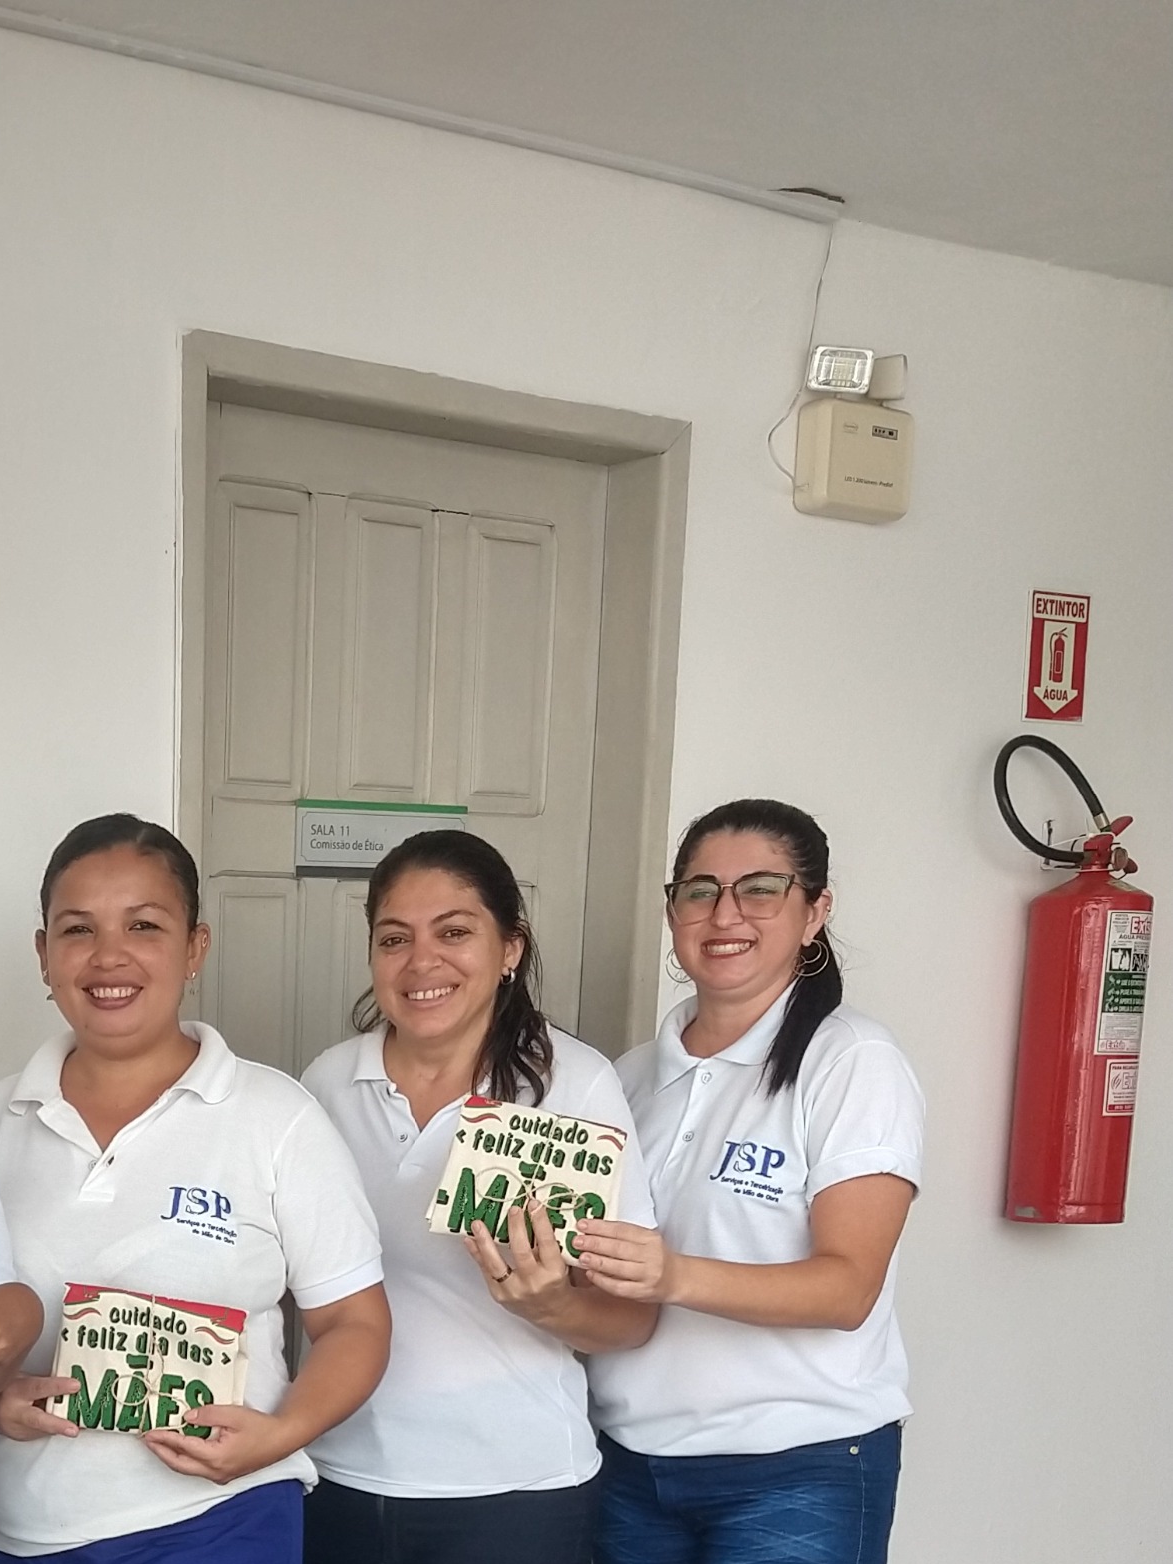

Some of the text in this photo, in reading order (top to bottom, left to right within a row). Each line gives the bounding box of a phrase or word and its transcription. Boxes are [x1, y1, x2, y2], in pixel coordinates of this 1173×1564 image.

[1035, 597, 1085, 618] EXTINTOR
[1043, 686, 1068, 701] ÁGUA
[310, 824, 350, 837] SALA 11
[310, 838, 384, 851] Comissão de Ética
[509, 1114, 589, 1145] cuidado
[472, 1128, 613, 1176] feliz dia das
[710, 1140, 785, 1180] JSP
[160, 1186, 231, 1221] JSP
[109, 1307, 187, 1335] cuidado
[77, 1325, 127, 1351] feliz
[177, 1338, 213, 1366] das
